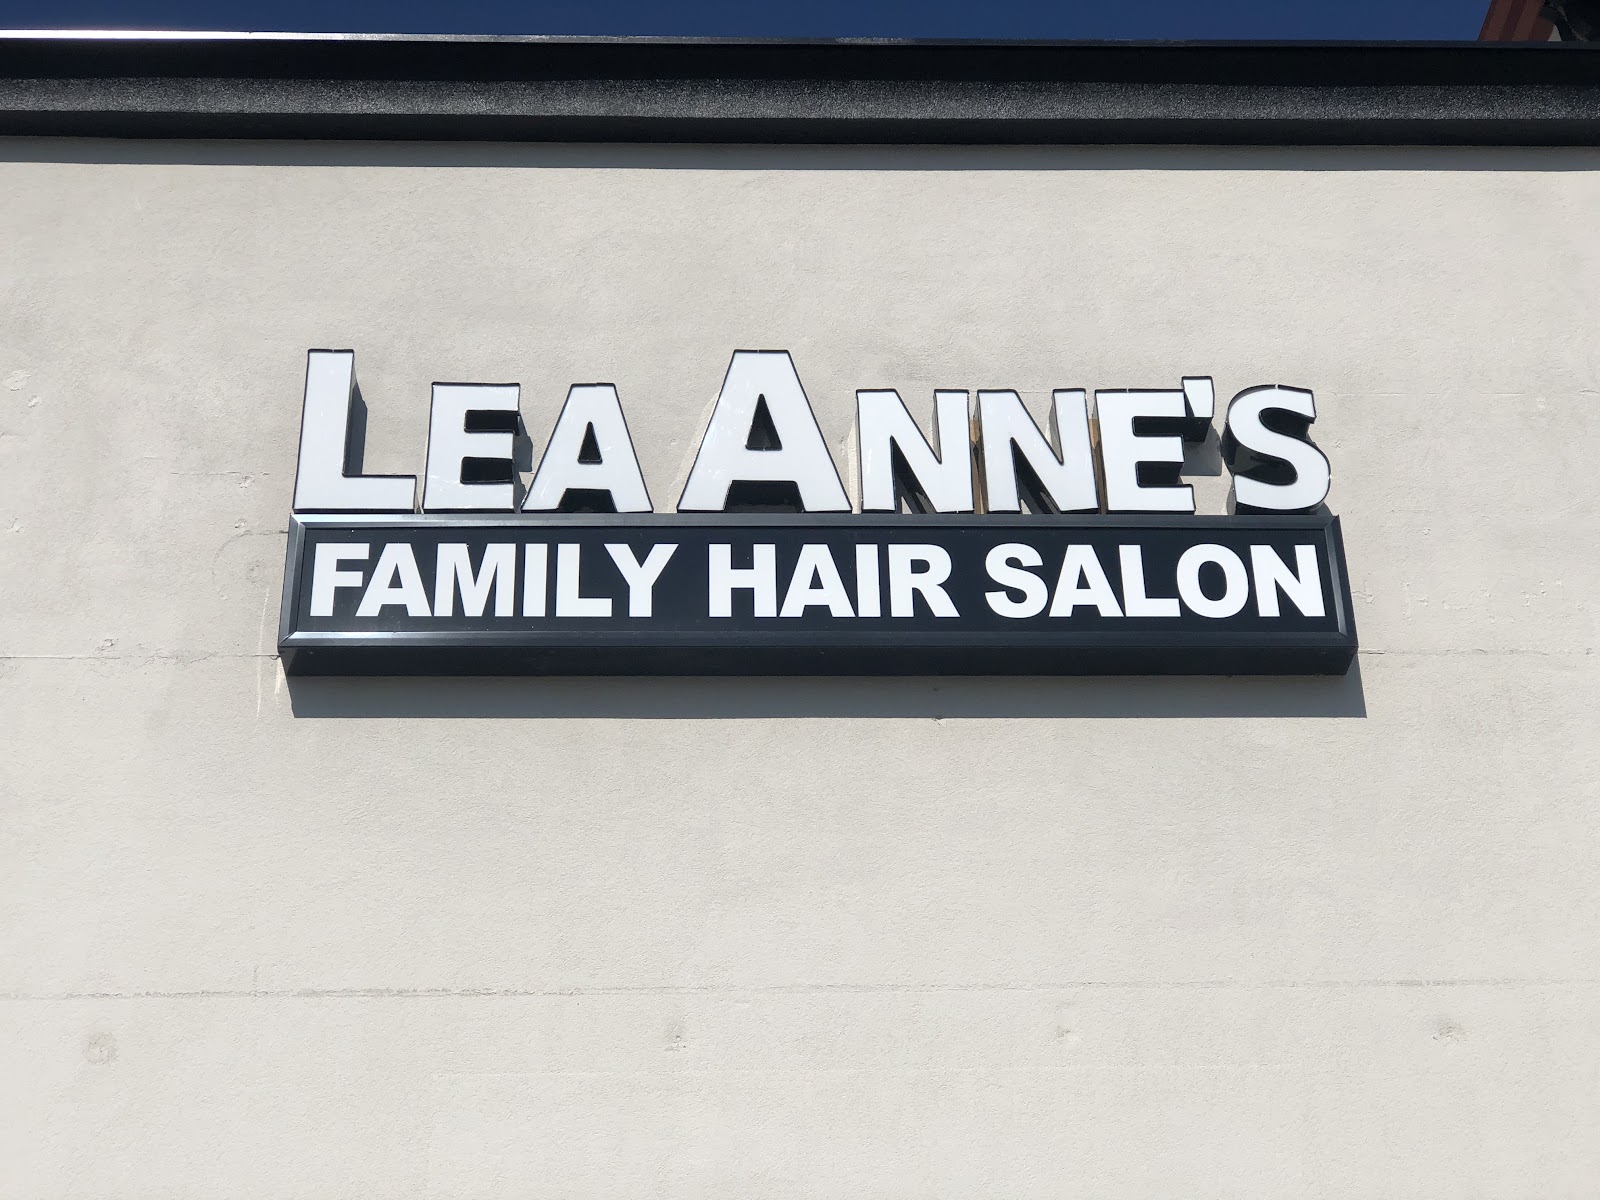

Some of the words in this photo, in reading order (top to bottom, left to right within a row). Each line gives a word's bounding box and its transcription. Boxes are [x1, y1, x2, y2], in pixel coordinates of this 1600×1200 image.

[293, 349, 653, 513] LEA
[677, 349, 1332, 514] ANNE'S
[309, 542, 679, 618] FAMILY
[708, 543, 960, 618] HAIR
[984, 543, 1326, 618] SALON
